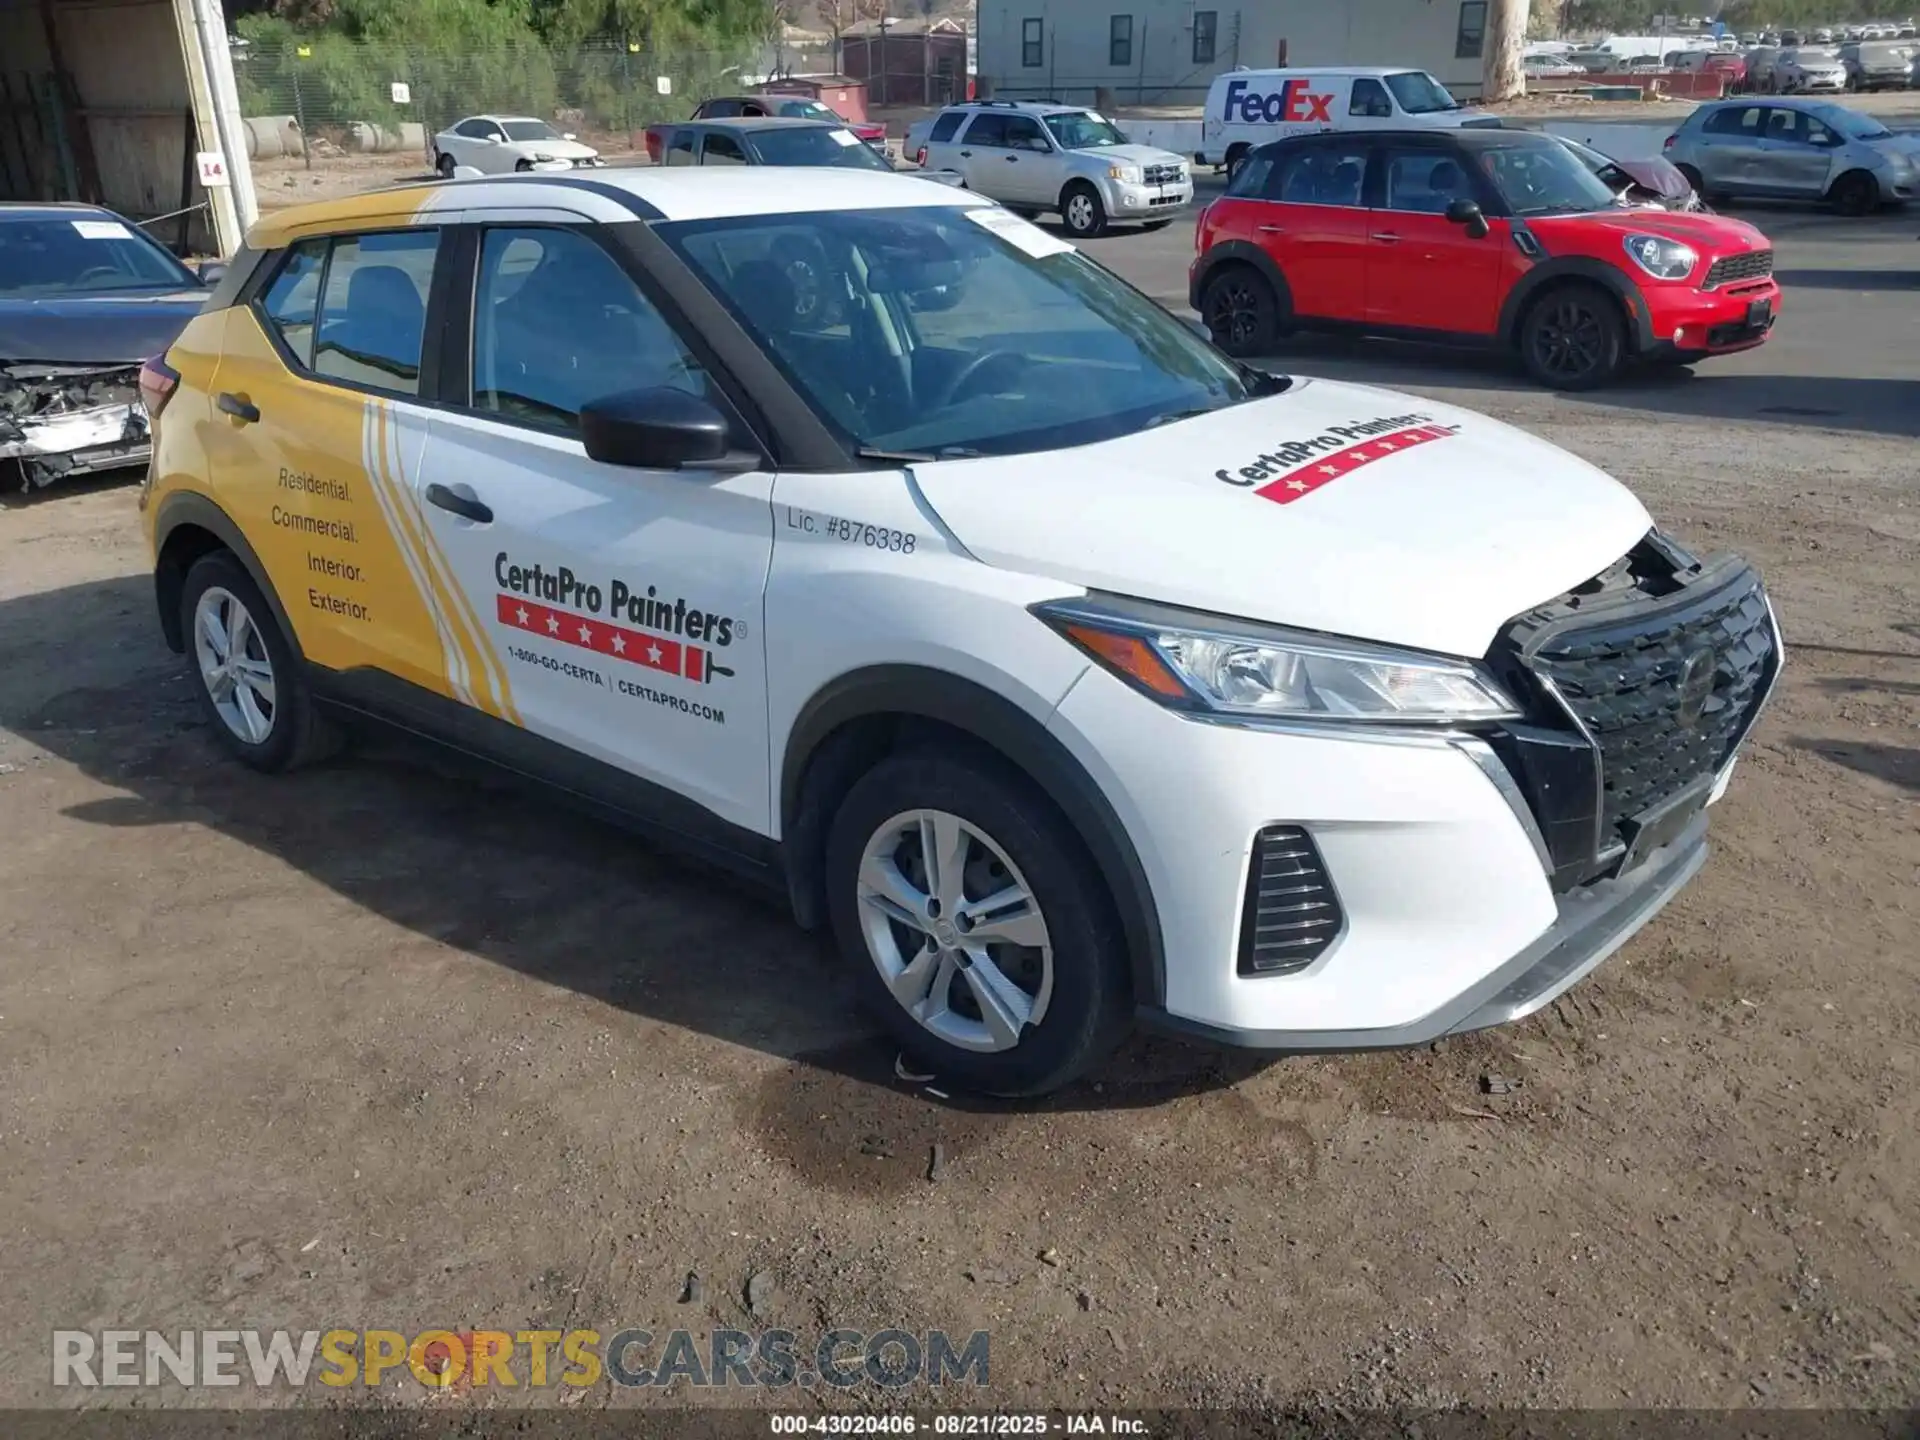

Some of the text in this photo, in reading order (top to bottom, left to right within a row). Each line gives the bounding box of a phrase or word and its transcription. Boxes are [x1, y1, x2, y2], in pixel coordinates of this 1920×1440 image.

[1223, 79, 1335, 122] FedEx
[204, 163, 222, 177] 14
[1215, 435, 1339, 487] CertaPro
[279, 467, 353, 502] Residential.
[271, 505, 359, 543] Commercial.
[787, 505, 917, 554] Lic. #876338
[307, 552, 366, 582] Interior.
[495, 551, 602, 613] CertaPro
[308, 588, 373, 622] Exterior.
[508, 646, 603, 686] 1-800-GO-CERTA
[618, 680, 725, 724] CERTAPRO.COM
